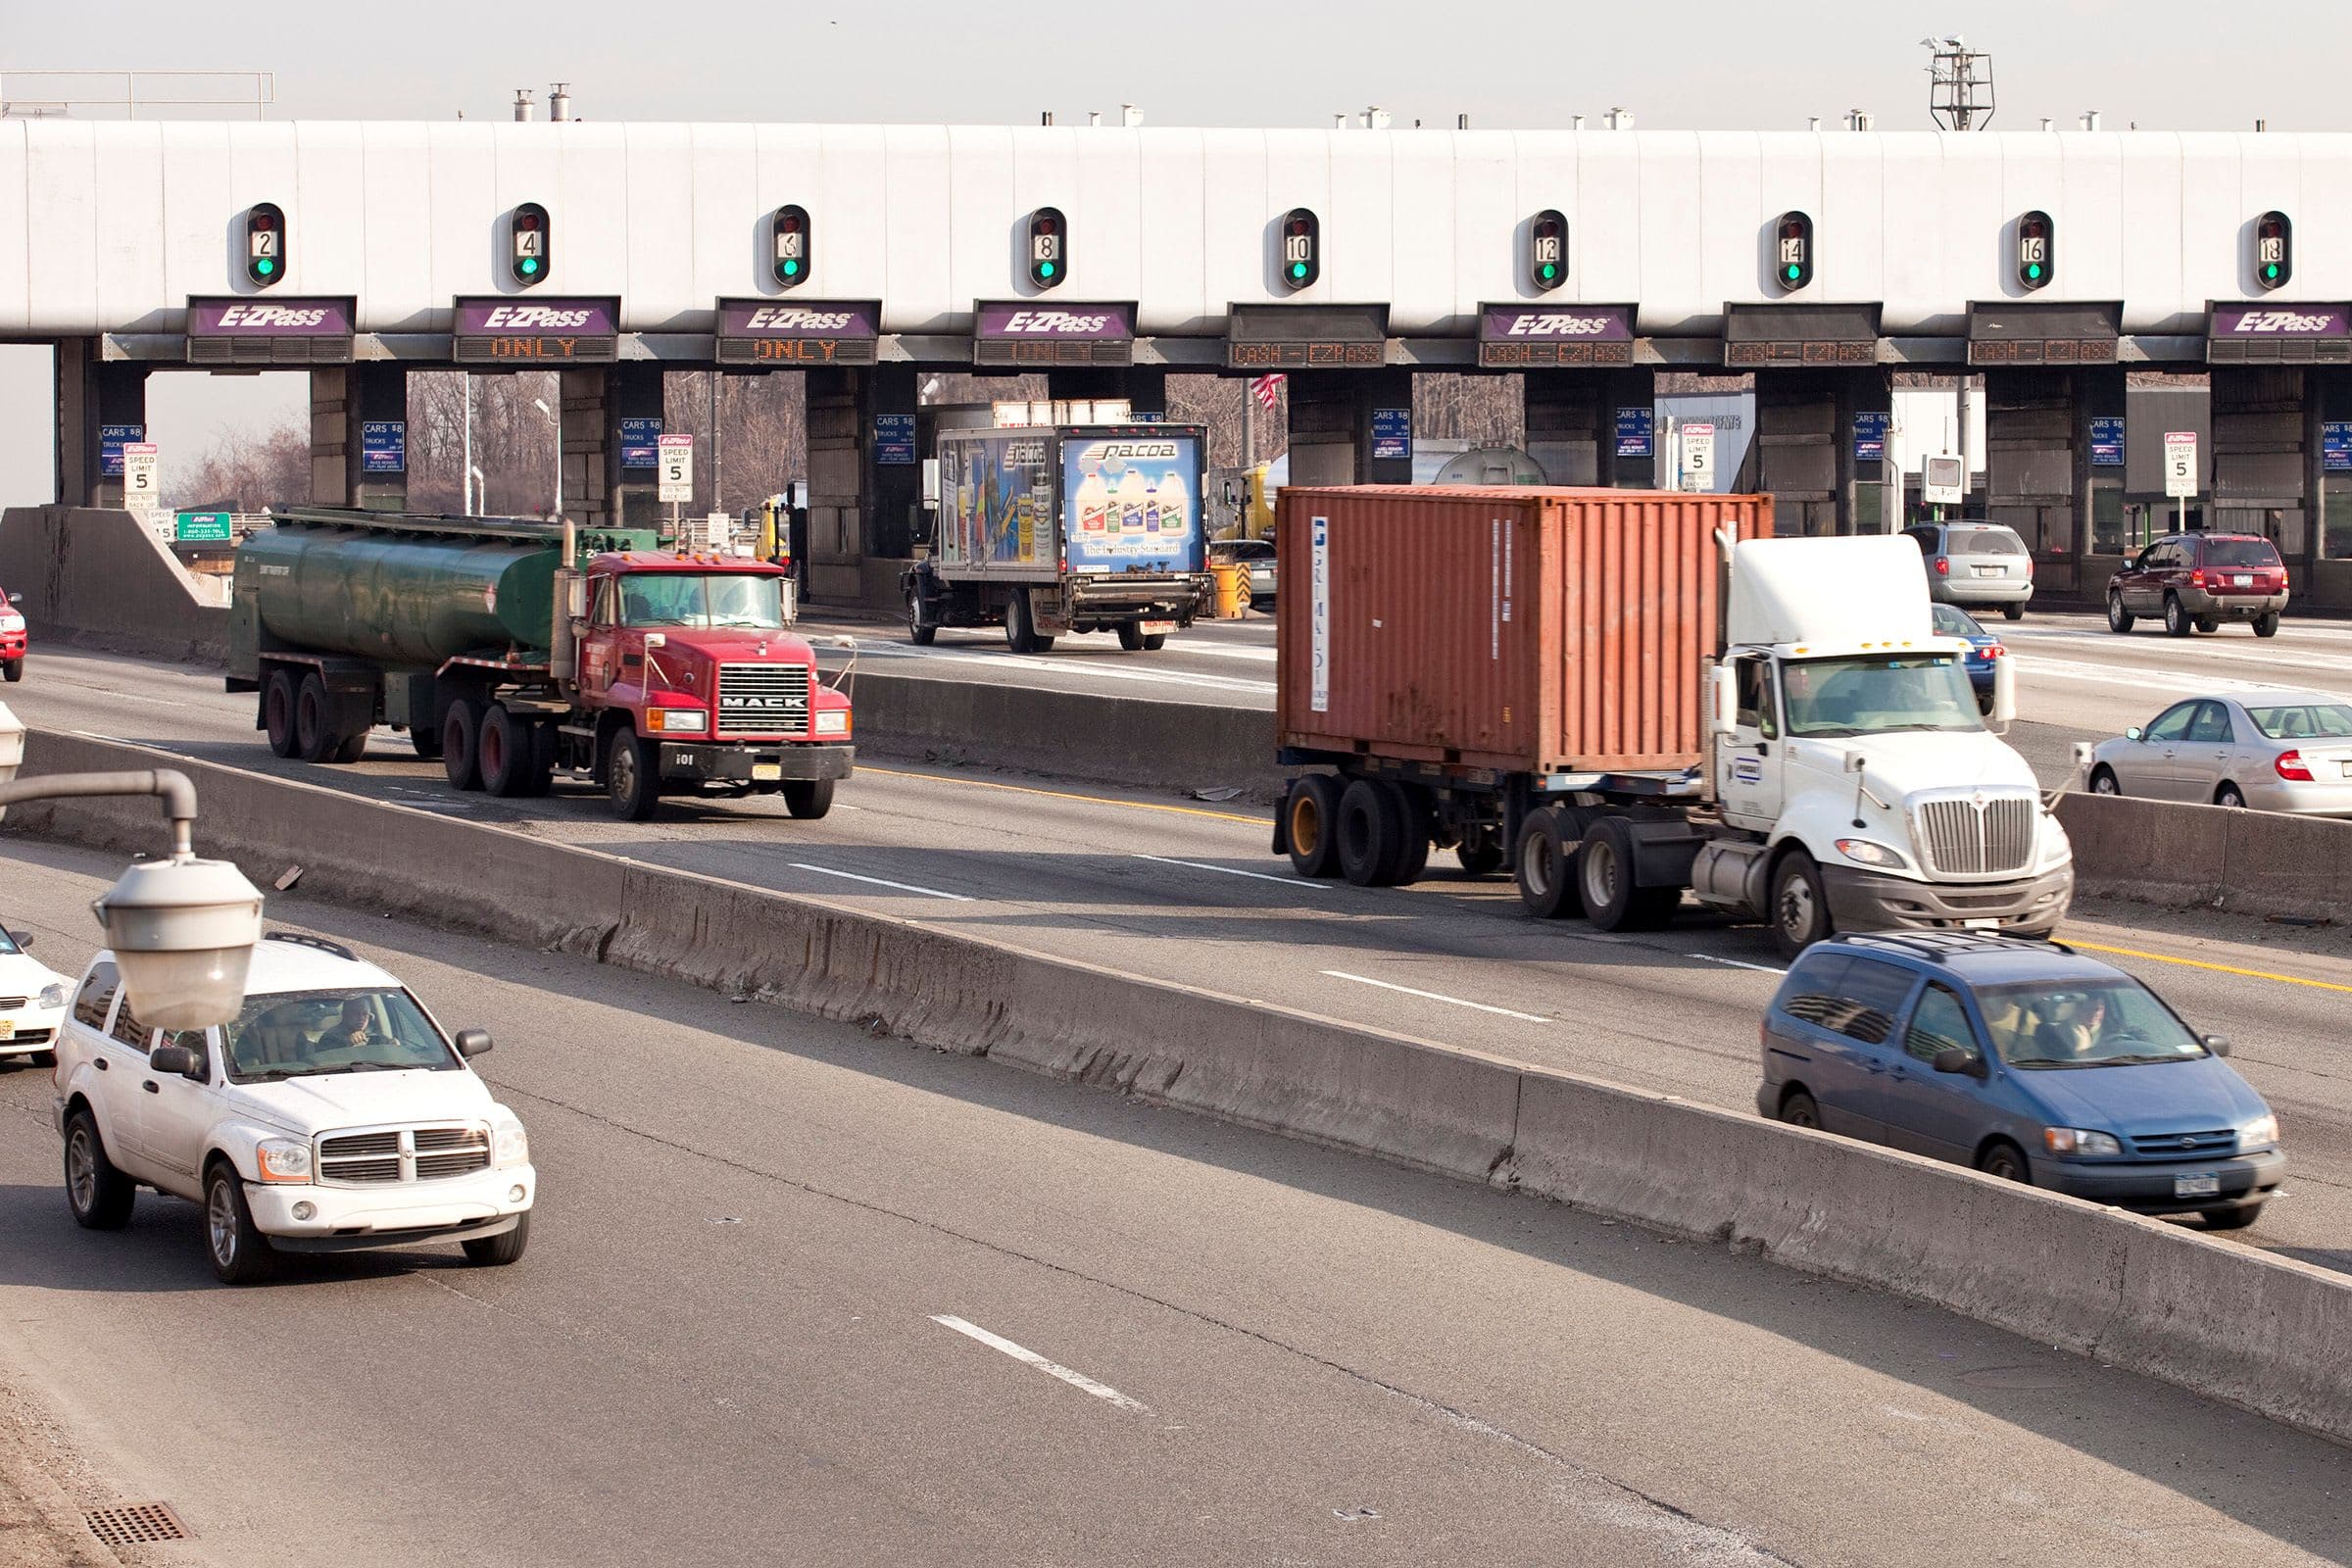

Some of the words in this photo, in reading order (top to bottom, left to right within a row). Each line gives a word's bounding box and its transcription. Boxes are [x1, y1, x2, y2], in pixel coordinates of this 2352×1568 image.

[260, 233, 271, 256] 2
[523, 232, 537, 256] 4
[784, 234, 797, 257] 6
[1041, 236, 1054, 258] 8
[1288, 237, 1308, 260] 10
[1536, 238, 1556, 260] 12
[1783, 239, 1802, 262] 14
[2023, 239, 2042, 261] 16
[492, 337, 578, 359] ONLY
[754, 339, 839, 361] ONLY
[1235, 343, 1281, 364] CASH
[1309, 343, 1380, 364] EZPASS
[1486, 343, 1531, 363] CASH
[876, 417, 899, 426] CARS
[903, 417, 913, 426] $8
[1397, 412, 1408, 420] $8
[1879, 415, 1888, 423] $8
[2113, 419, 2124, 428] $8
[102, 428, 125, 437] CARS
[129, 428, 141, 437] $8
[365, 424, 388, 433] CARS
[391, 424, 403, 433] $8
[622, 421, 645, 430] CARS
[650, 421, 661, 430] $8
[2324, 424, 2340, 433] ARS
[1101, 444, 1176, 461] pacoa
[1692, 455, 1703, 468] 5
[2177, 462, 2187, 476] 5
[136, 473, 148, 489] 5
[669, 466, 682, 480] 5
[1085, 544, 1102, 554] The
[1102, 544, 1138, 557] Industry
[1140, 543, 1179, 554] Standard
[721, 698, 807, 708] MACK
